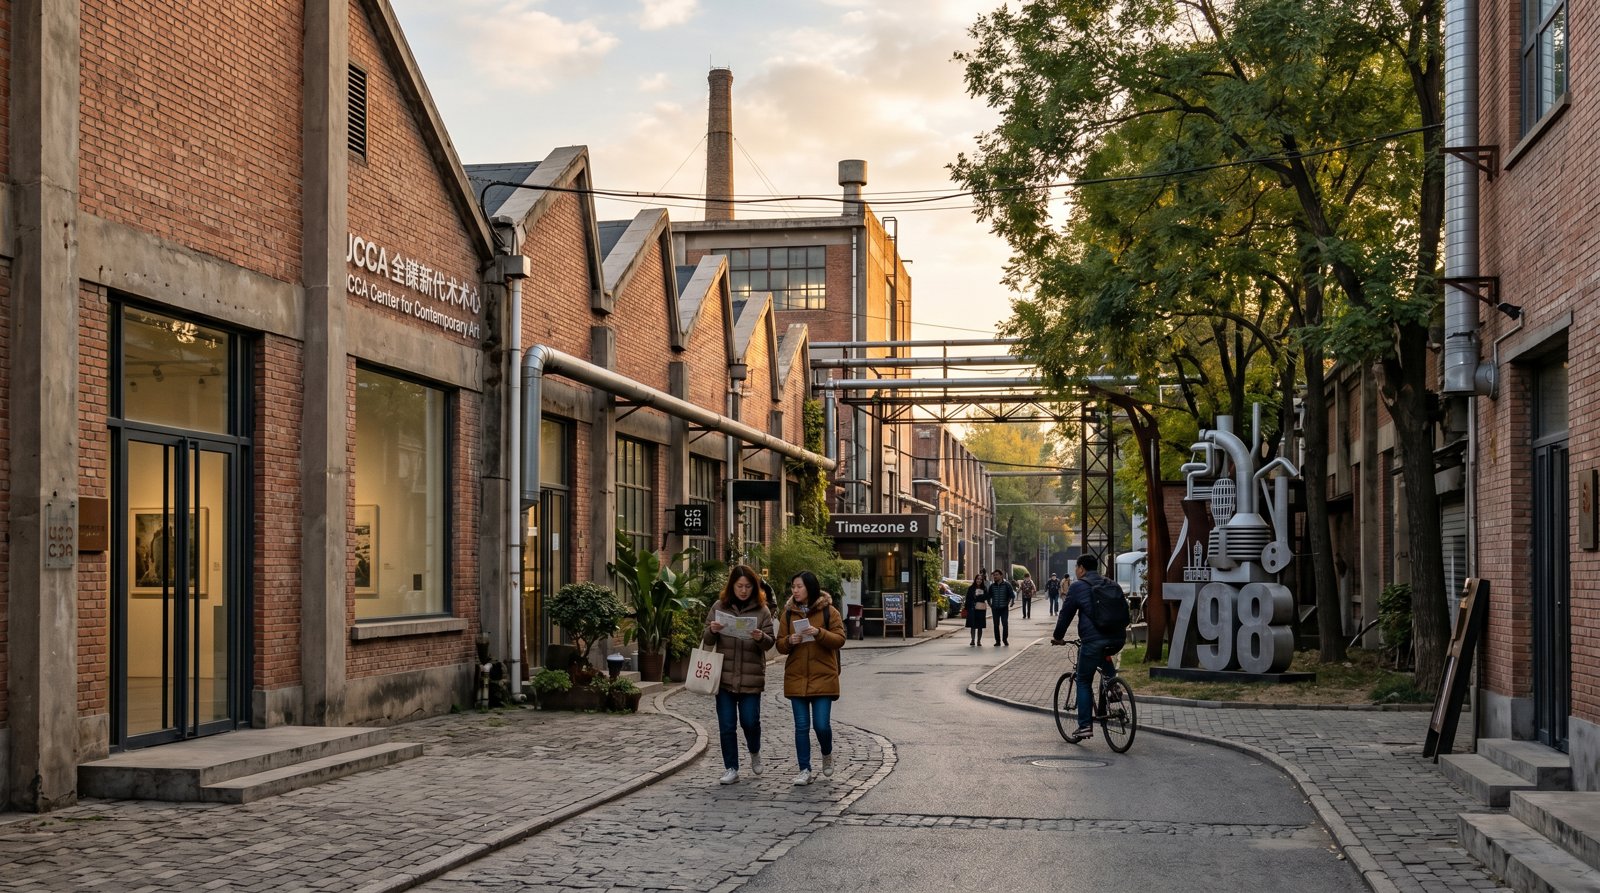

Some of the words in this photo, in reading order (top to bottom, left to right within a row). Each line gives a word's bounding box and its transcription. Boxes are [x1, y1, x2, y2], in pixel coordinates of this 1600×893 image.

[345, 272, 369, 298] CCA
[370, 283, 399, 310] Center
[401, 294, 413, 315] for
[414, 300, 468, 339] Contemporary
[468, 320, 480, 340] Art
[835, 520, 905, 533] Timezone
[909, 520, 919, 533] 8
[1162, 582, 1294, 673] 798
